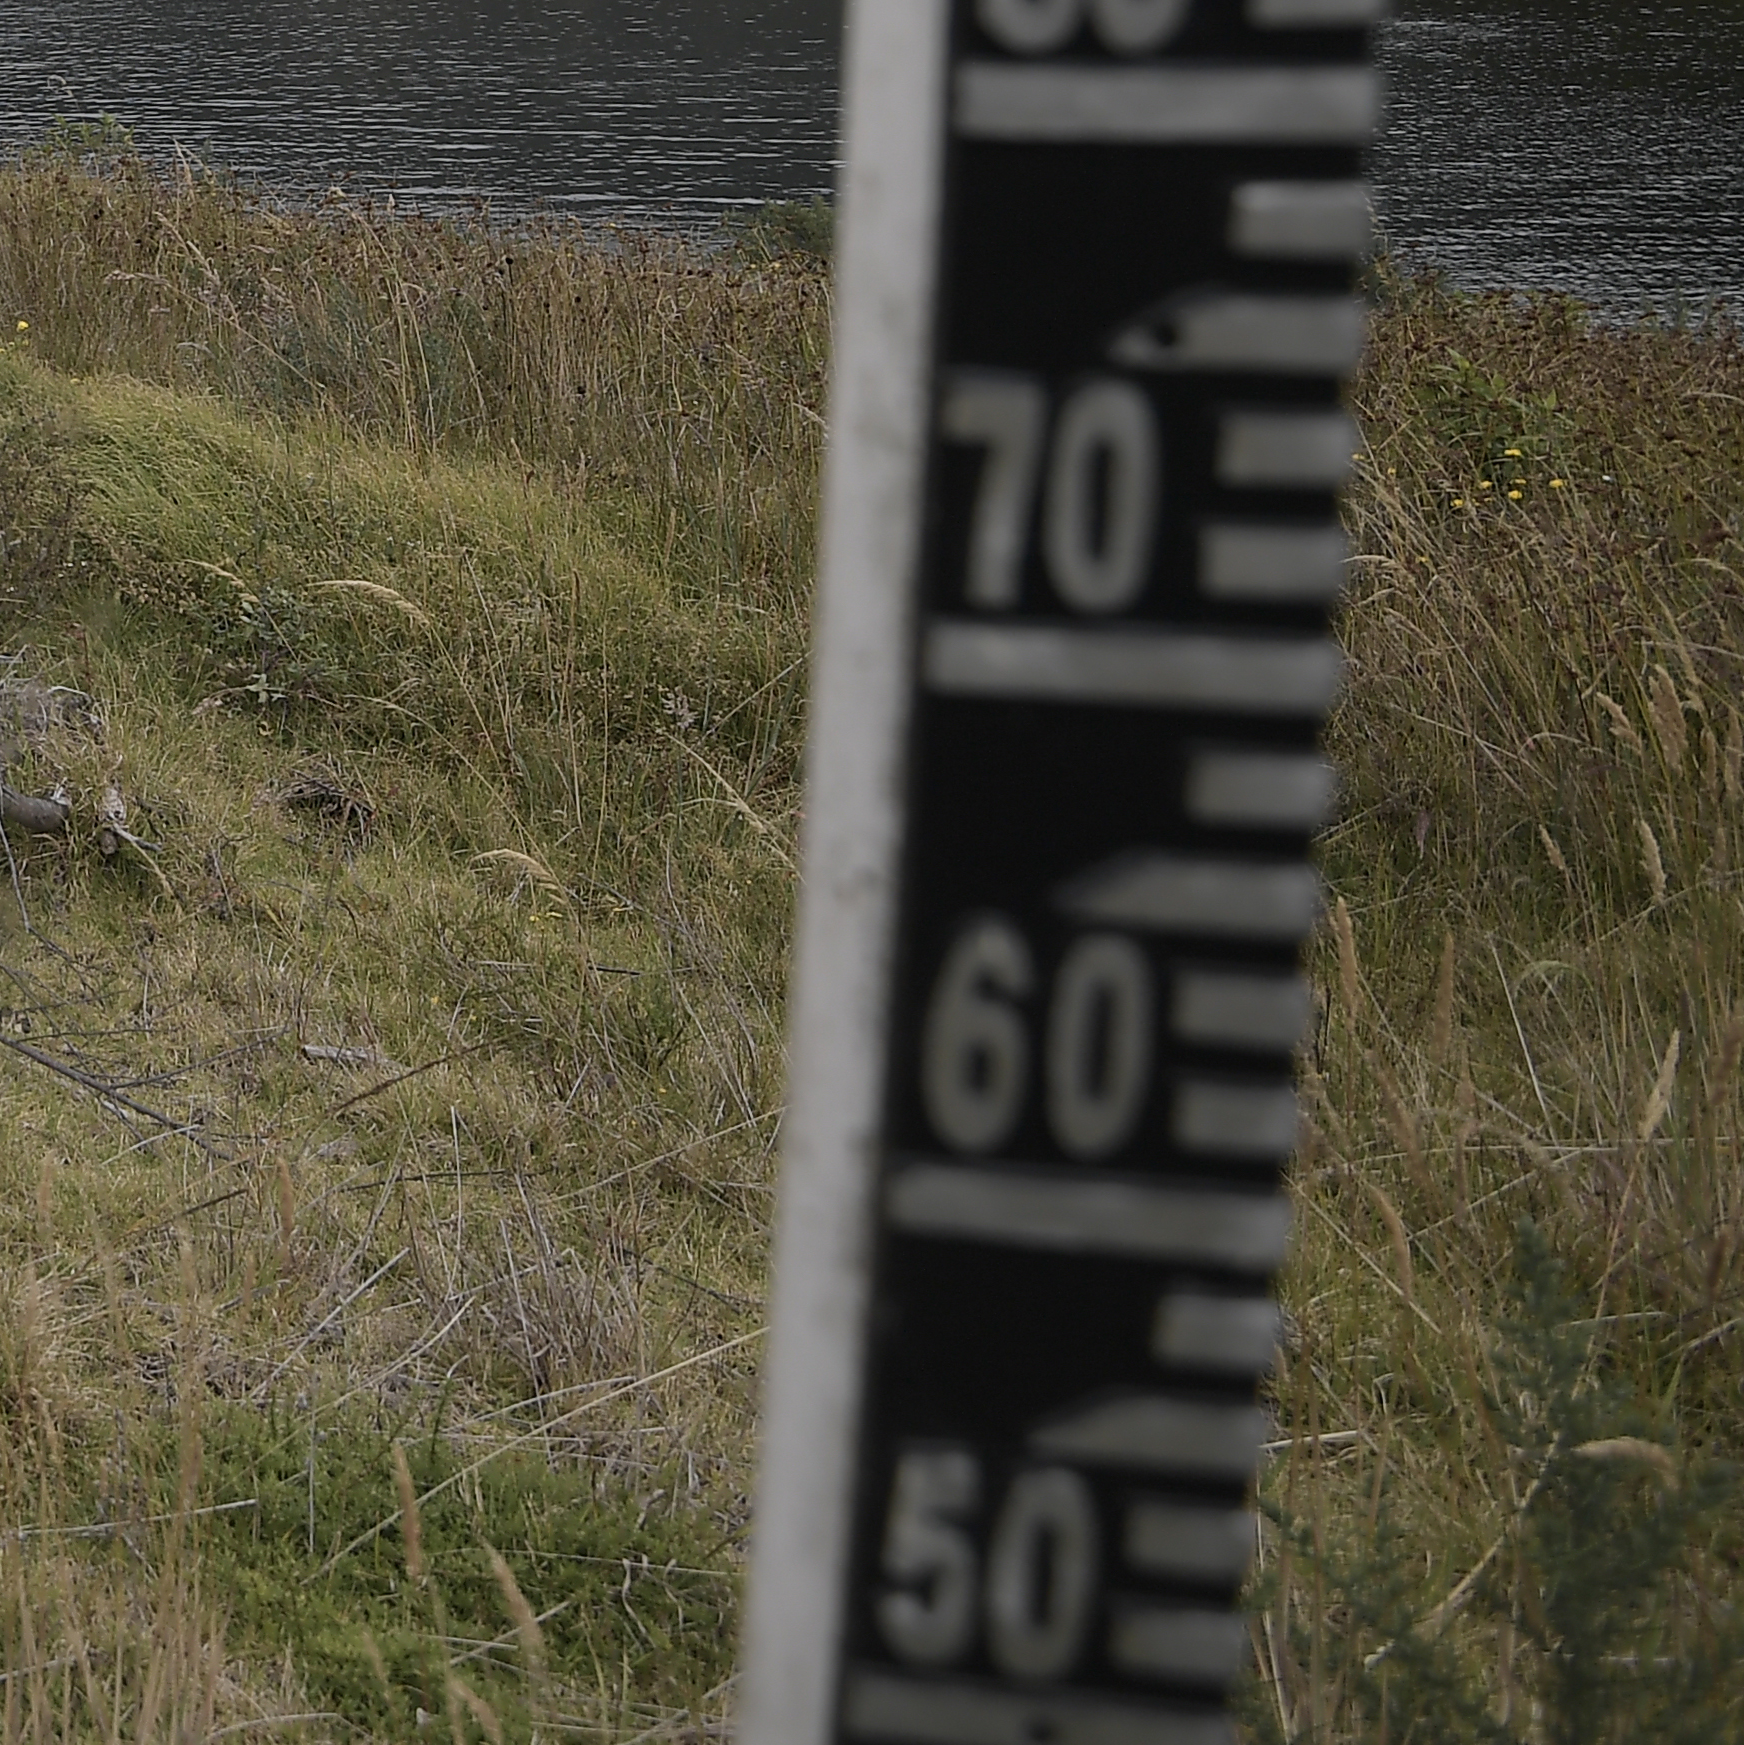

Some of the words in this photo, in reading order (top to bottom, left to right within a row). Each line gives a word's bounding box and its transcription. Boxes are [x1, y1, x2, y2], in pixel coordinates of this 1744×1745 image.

[938, 366, 1161, 614] 70
[919, 906, 1156, 1159] 60
[872, 1446, 1104, 1681] 50
